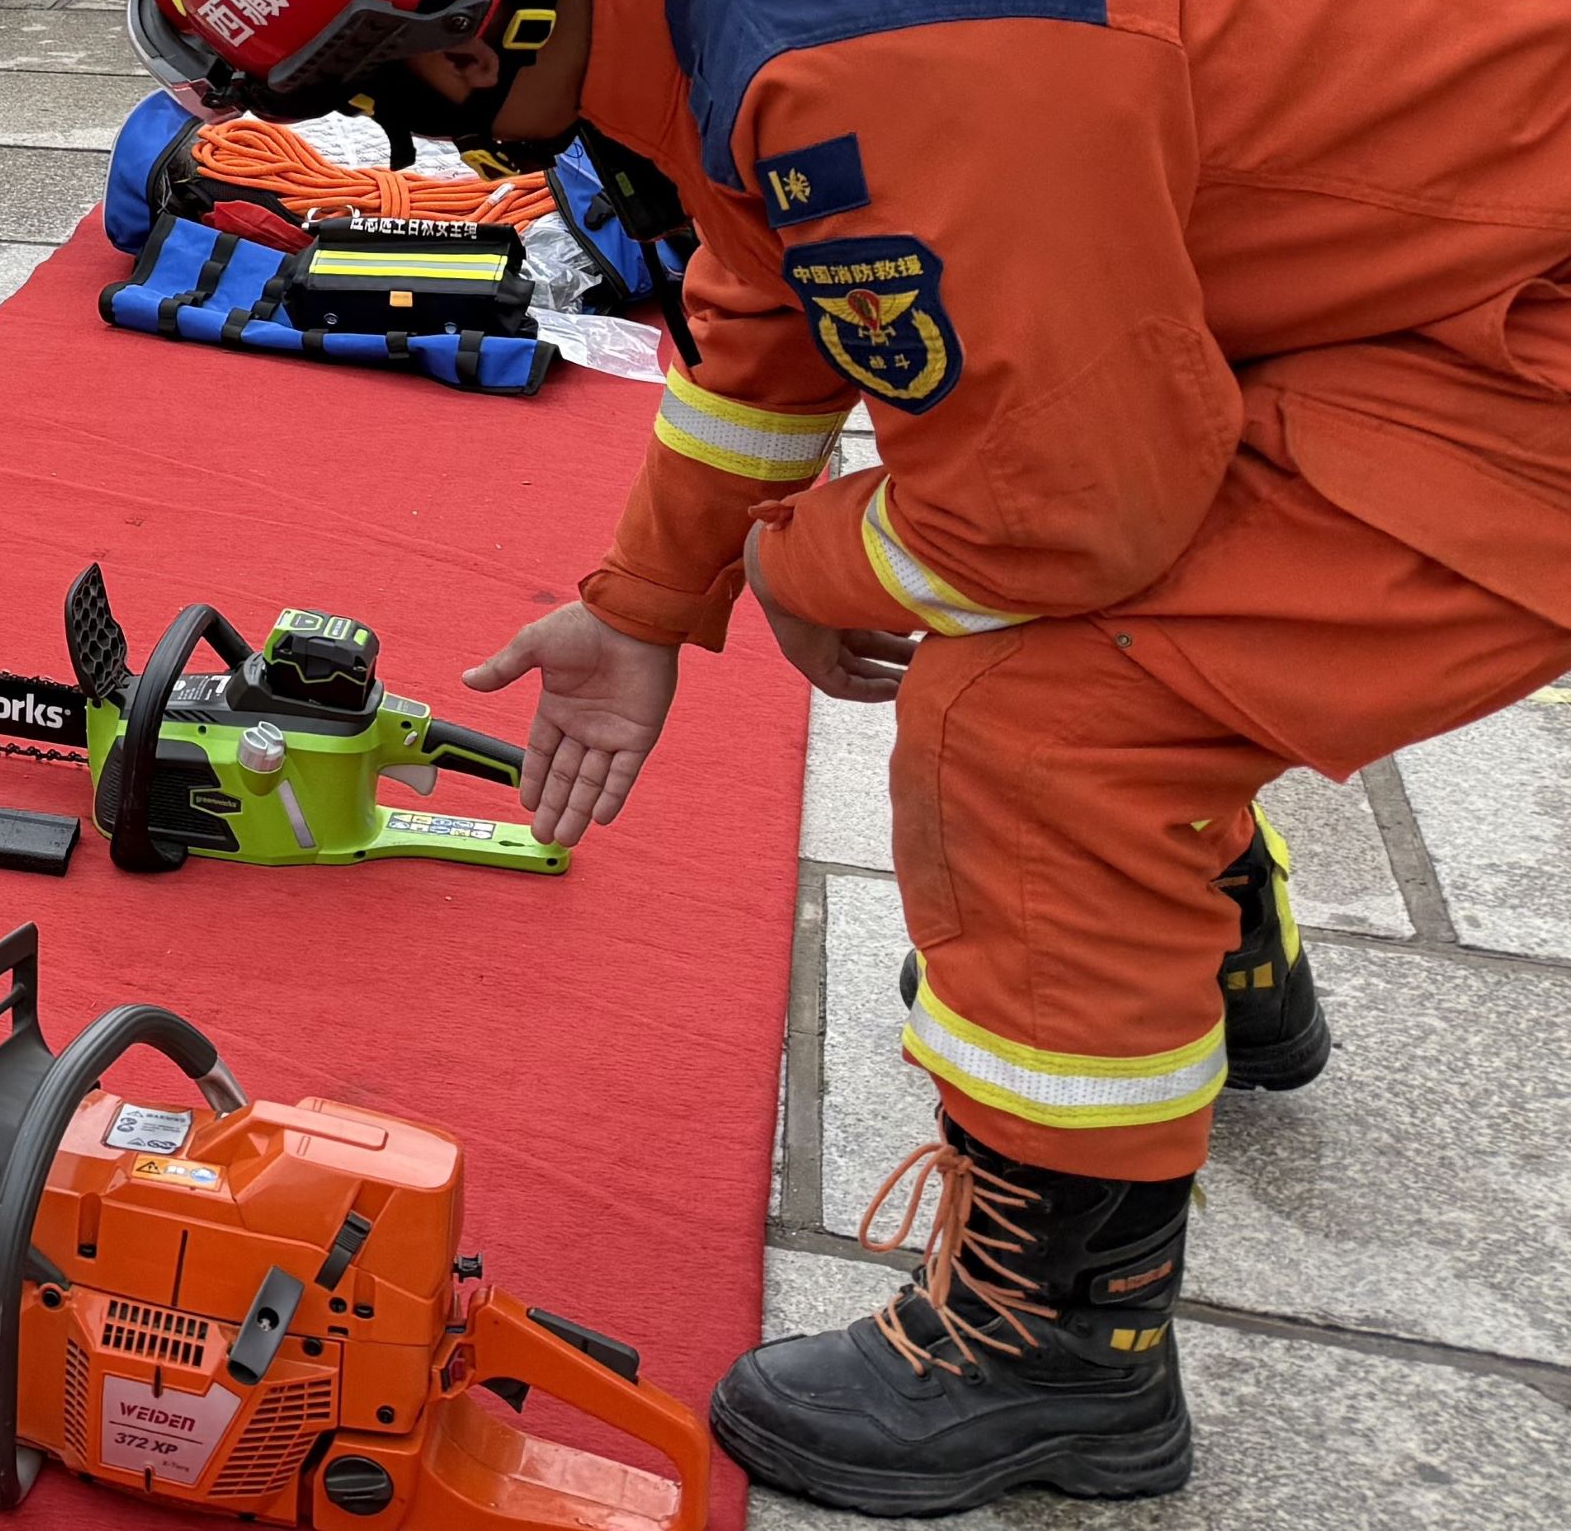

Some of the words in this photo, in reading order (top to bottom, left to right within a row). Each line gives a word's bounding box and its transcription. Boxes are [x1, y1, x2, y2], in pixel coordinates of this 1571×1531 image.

[793, 254, 924, 285] 中国消防救援
[120, 1401, 196, 1433] WEIDEN
[114, 1432, 149, 1450] 372
[151, 1440, 179, 1455] XP
